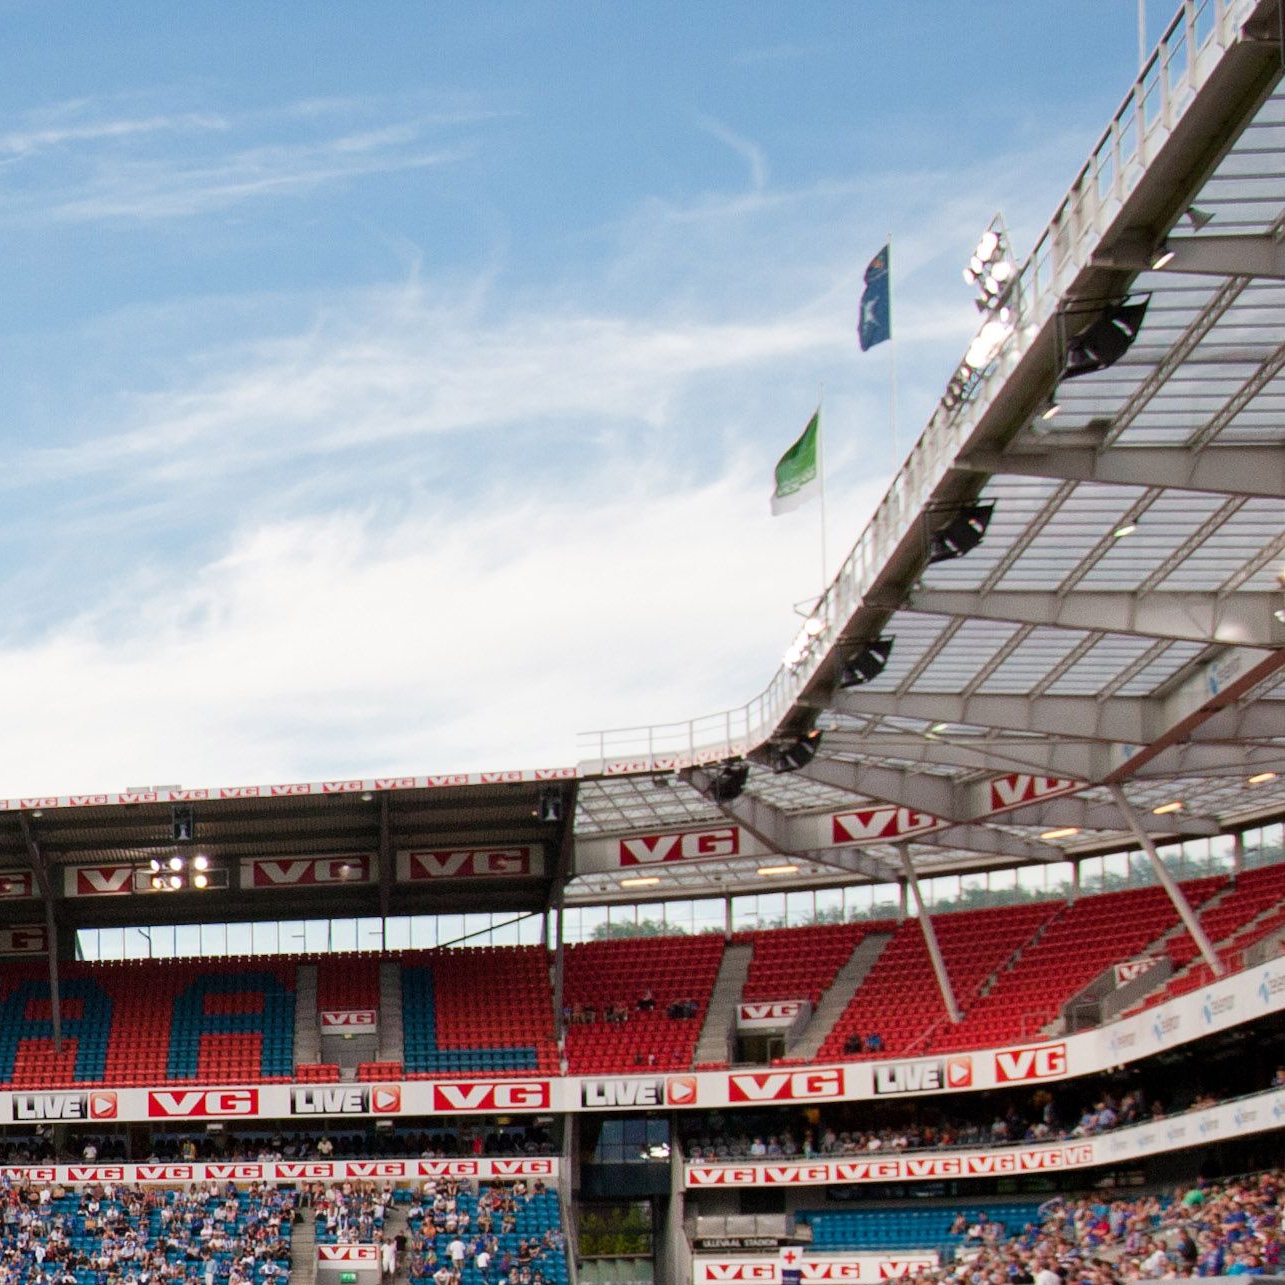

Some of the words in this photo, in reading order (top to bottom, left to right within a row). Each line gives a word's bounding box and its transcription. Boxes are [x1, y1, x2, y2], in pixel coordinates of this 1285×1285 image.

[625, 830, 735, 863] VG
[415, 850, 525, 877] VG
[258, 858, 366, 885] VG
[324, 1013, 373, 1025] VG
[744, 1004, 802, 1019] VG
[999, 1047, 1064, 1081] VG
[734, 1071, 840, 1099] VG
[877, 1063, 944, 1093] LIVE
[295, 1087, 368, 1112] LIVE
[438, 1084, 546, 1109] VG
[585, 1081, 663, 1107] LIVE
[18, 1095, 87, 1119] LIVE
[153, 1092, 255, 1116] VG
[1022, 1152, 1060, 1167] VG
[1067, 1146, 1091, 1163] VG
[208, 1166, 260, 1177] VG
[278, 1165, 331, 1176] VG
[349, 1163, 403, 1175] VG
[421, 1162, 475, 1174] VG
[494, 1161, 549, 1173] VG
[839, 1163, 897, 1178] VG
[910, 1160, 960, 1175] VG
[971, 1156, 1012, 1172] VG
[71, 1168, 122, 1179] VG
[139, 1167, 191, 1178] VG
[692, 1169, 753, 1183] VG
[767, 1166, 827, 1180] VG
[321, 1246, 377, 1259] VG
[709, 1265, 772, 1278] VG
[804, 1264, 858, 1278] VG
